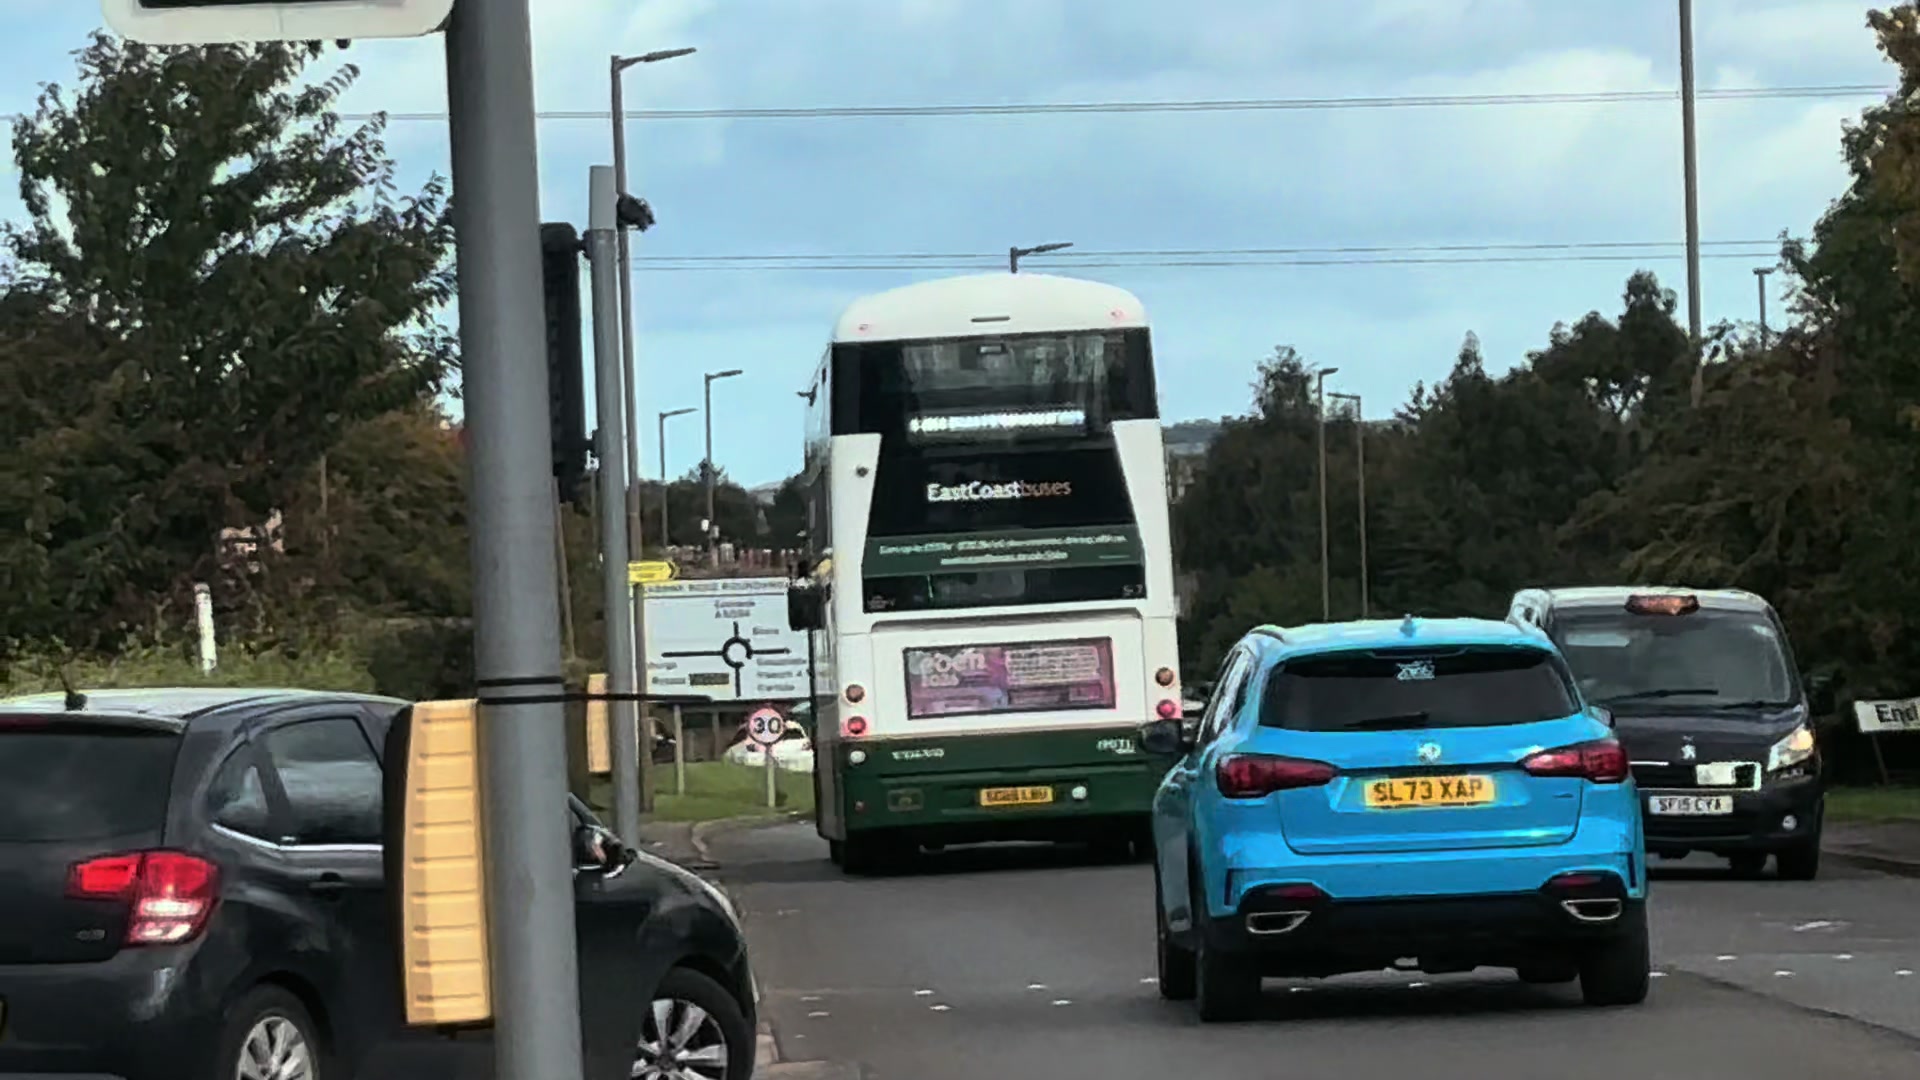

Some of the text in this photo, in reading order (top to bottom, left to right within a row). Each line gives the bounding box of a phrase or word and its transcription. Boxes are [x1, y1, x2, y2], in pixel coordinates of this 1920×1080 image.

[1874, 702, 1920, 723] End
[753, 716, 782, 734] 30
[1373, 778, 1483, 802] SL73 XAP
